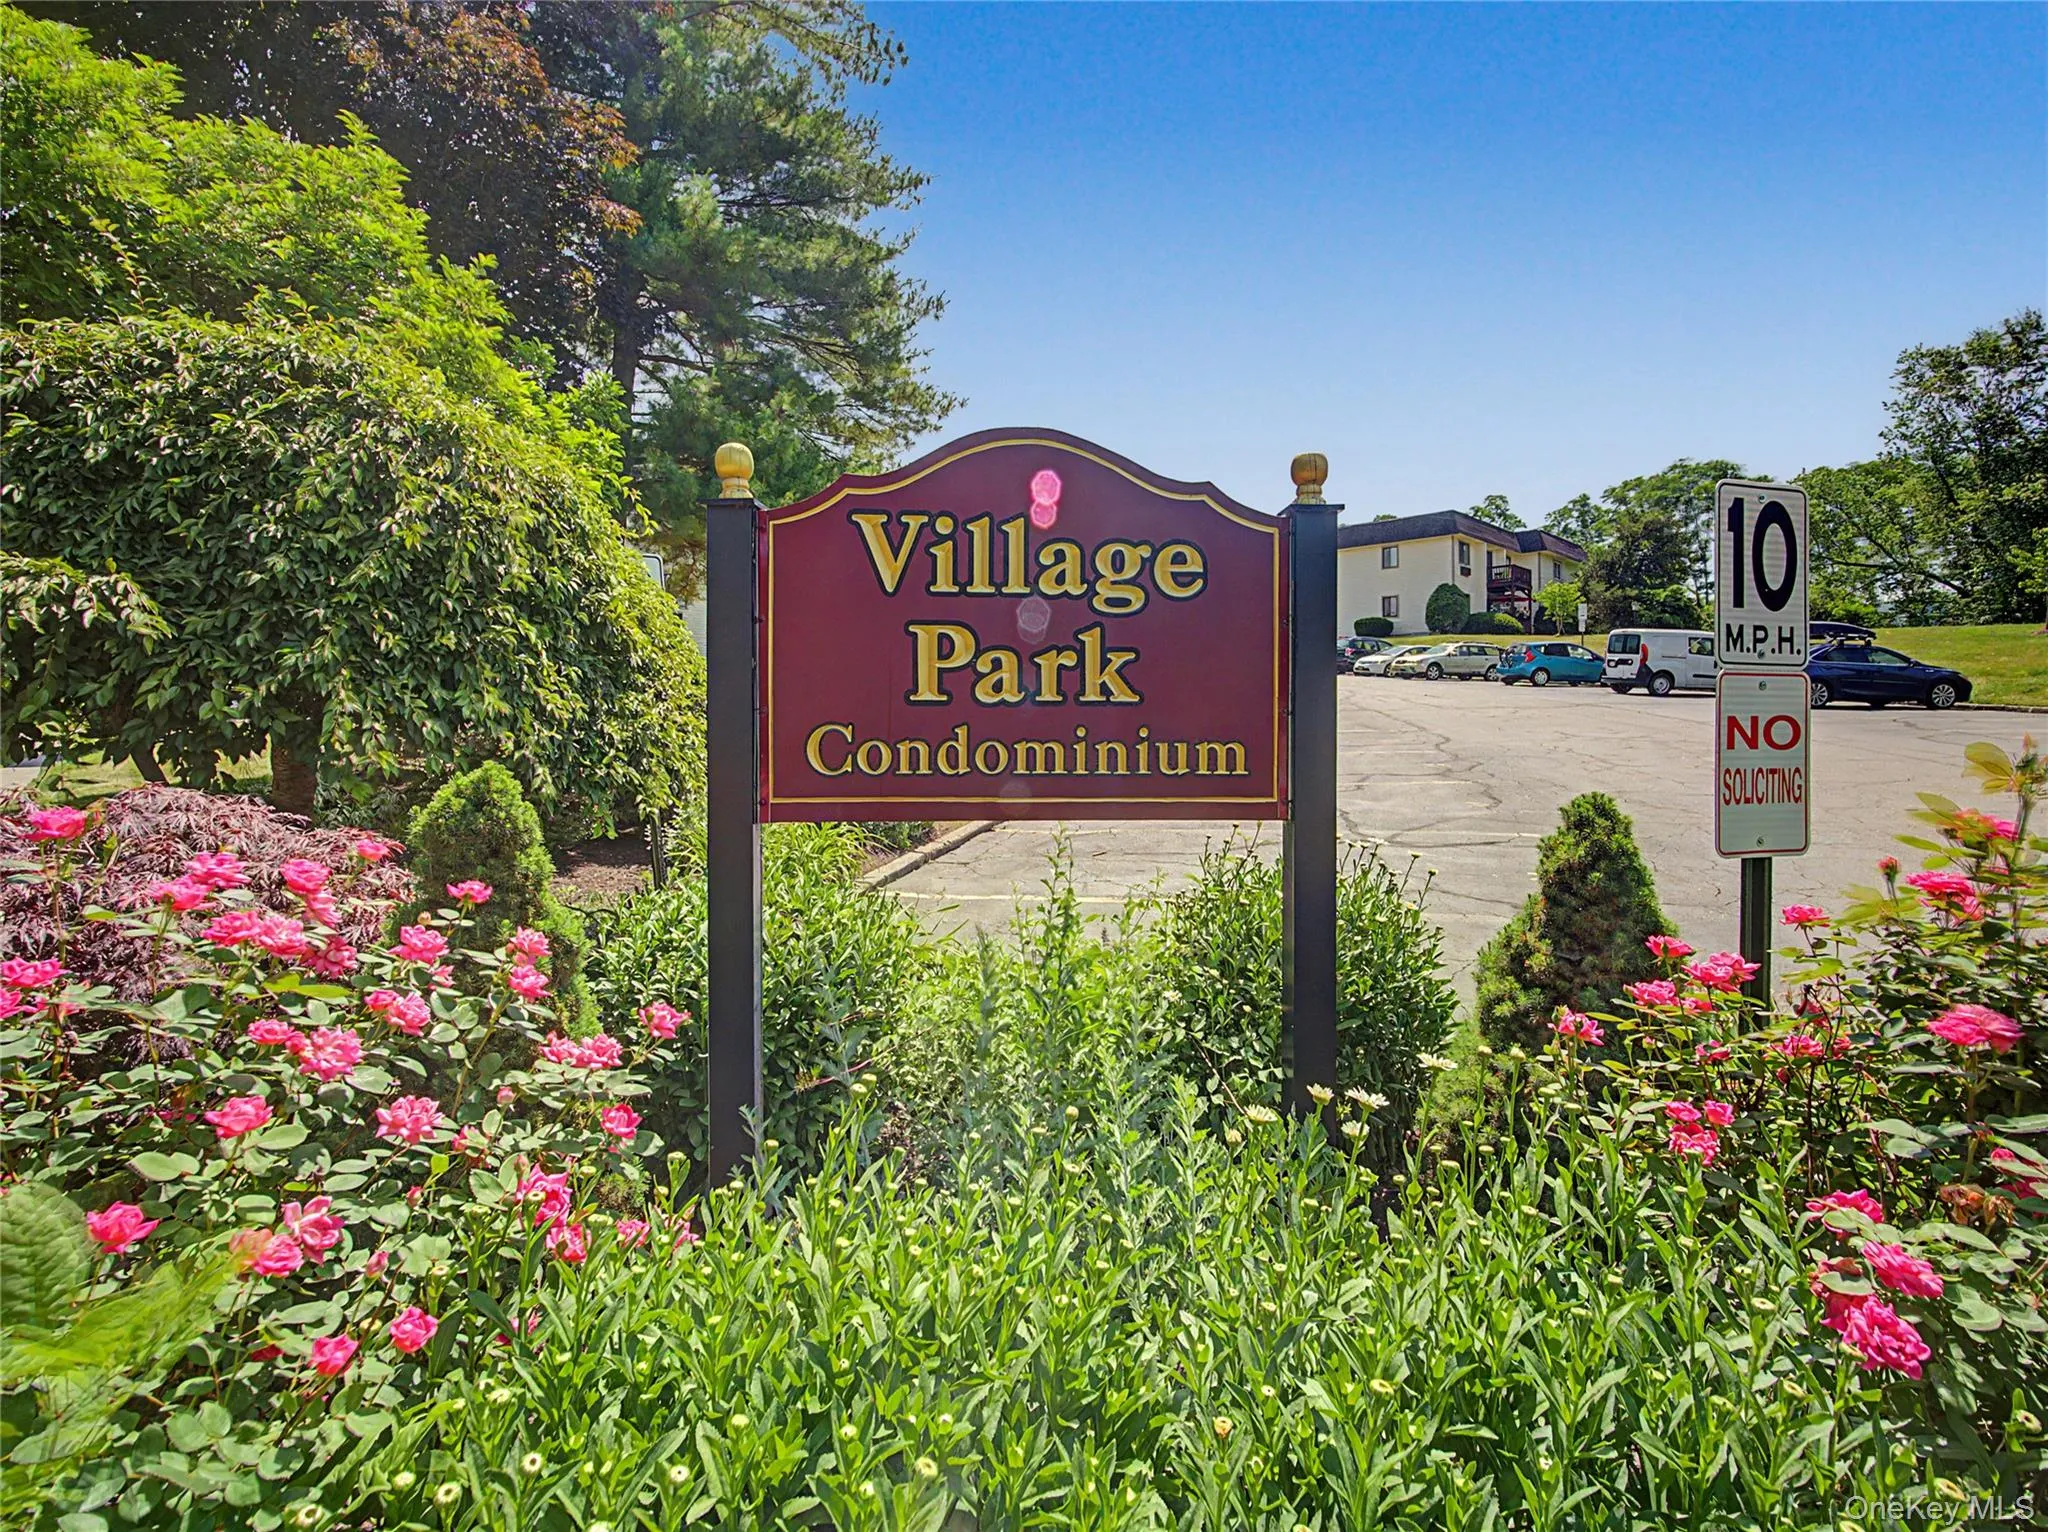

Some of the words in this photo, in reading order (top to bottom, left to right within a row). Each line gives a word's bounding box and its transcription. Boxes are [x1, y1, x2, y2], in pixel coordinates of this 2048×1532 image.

[849, 509, 1206, 616] Village
[1727, 497, 1798, 612] 10
[906, 622, 1142, 704] Park
[1725, 623, 1802, 656] M.P.H.
[806, 723, 1249, 777] Condominium
[1726, 715, 1801, 750] NO
[1723, 767, 1803, 807] SOLICITING
